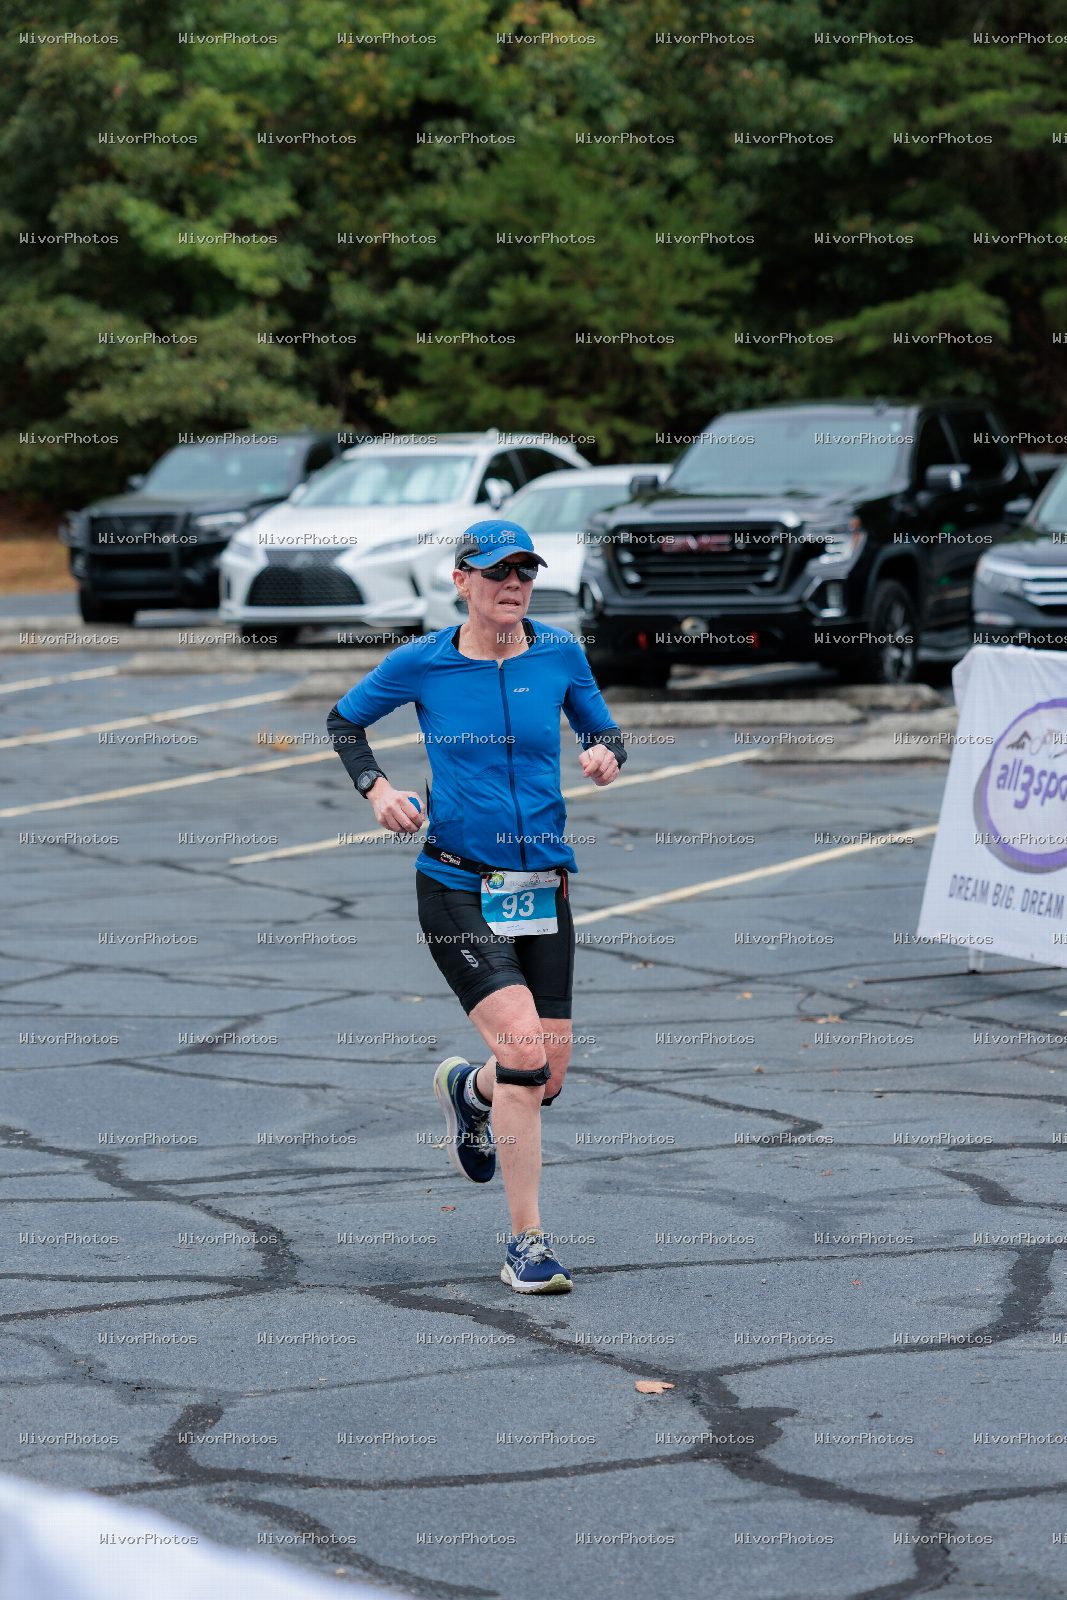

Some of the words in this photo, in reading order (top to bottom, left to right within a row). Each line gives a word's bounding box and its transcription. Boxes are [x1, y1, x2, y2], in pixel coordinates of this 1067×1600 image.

[502, 891, 535, 918] 93
[948, 874, 990, 905] DREAM
[1021, 888, 1065, 920] DREAM
